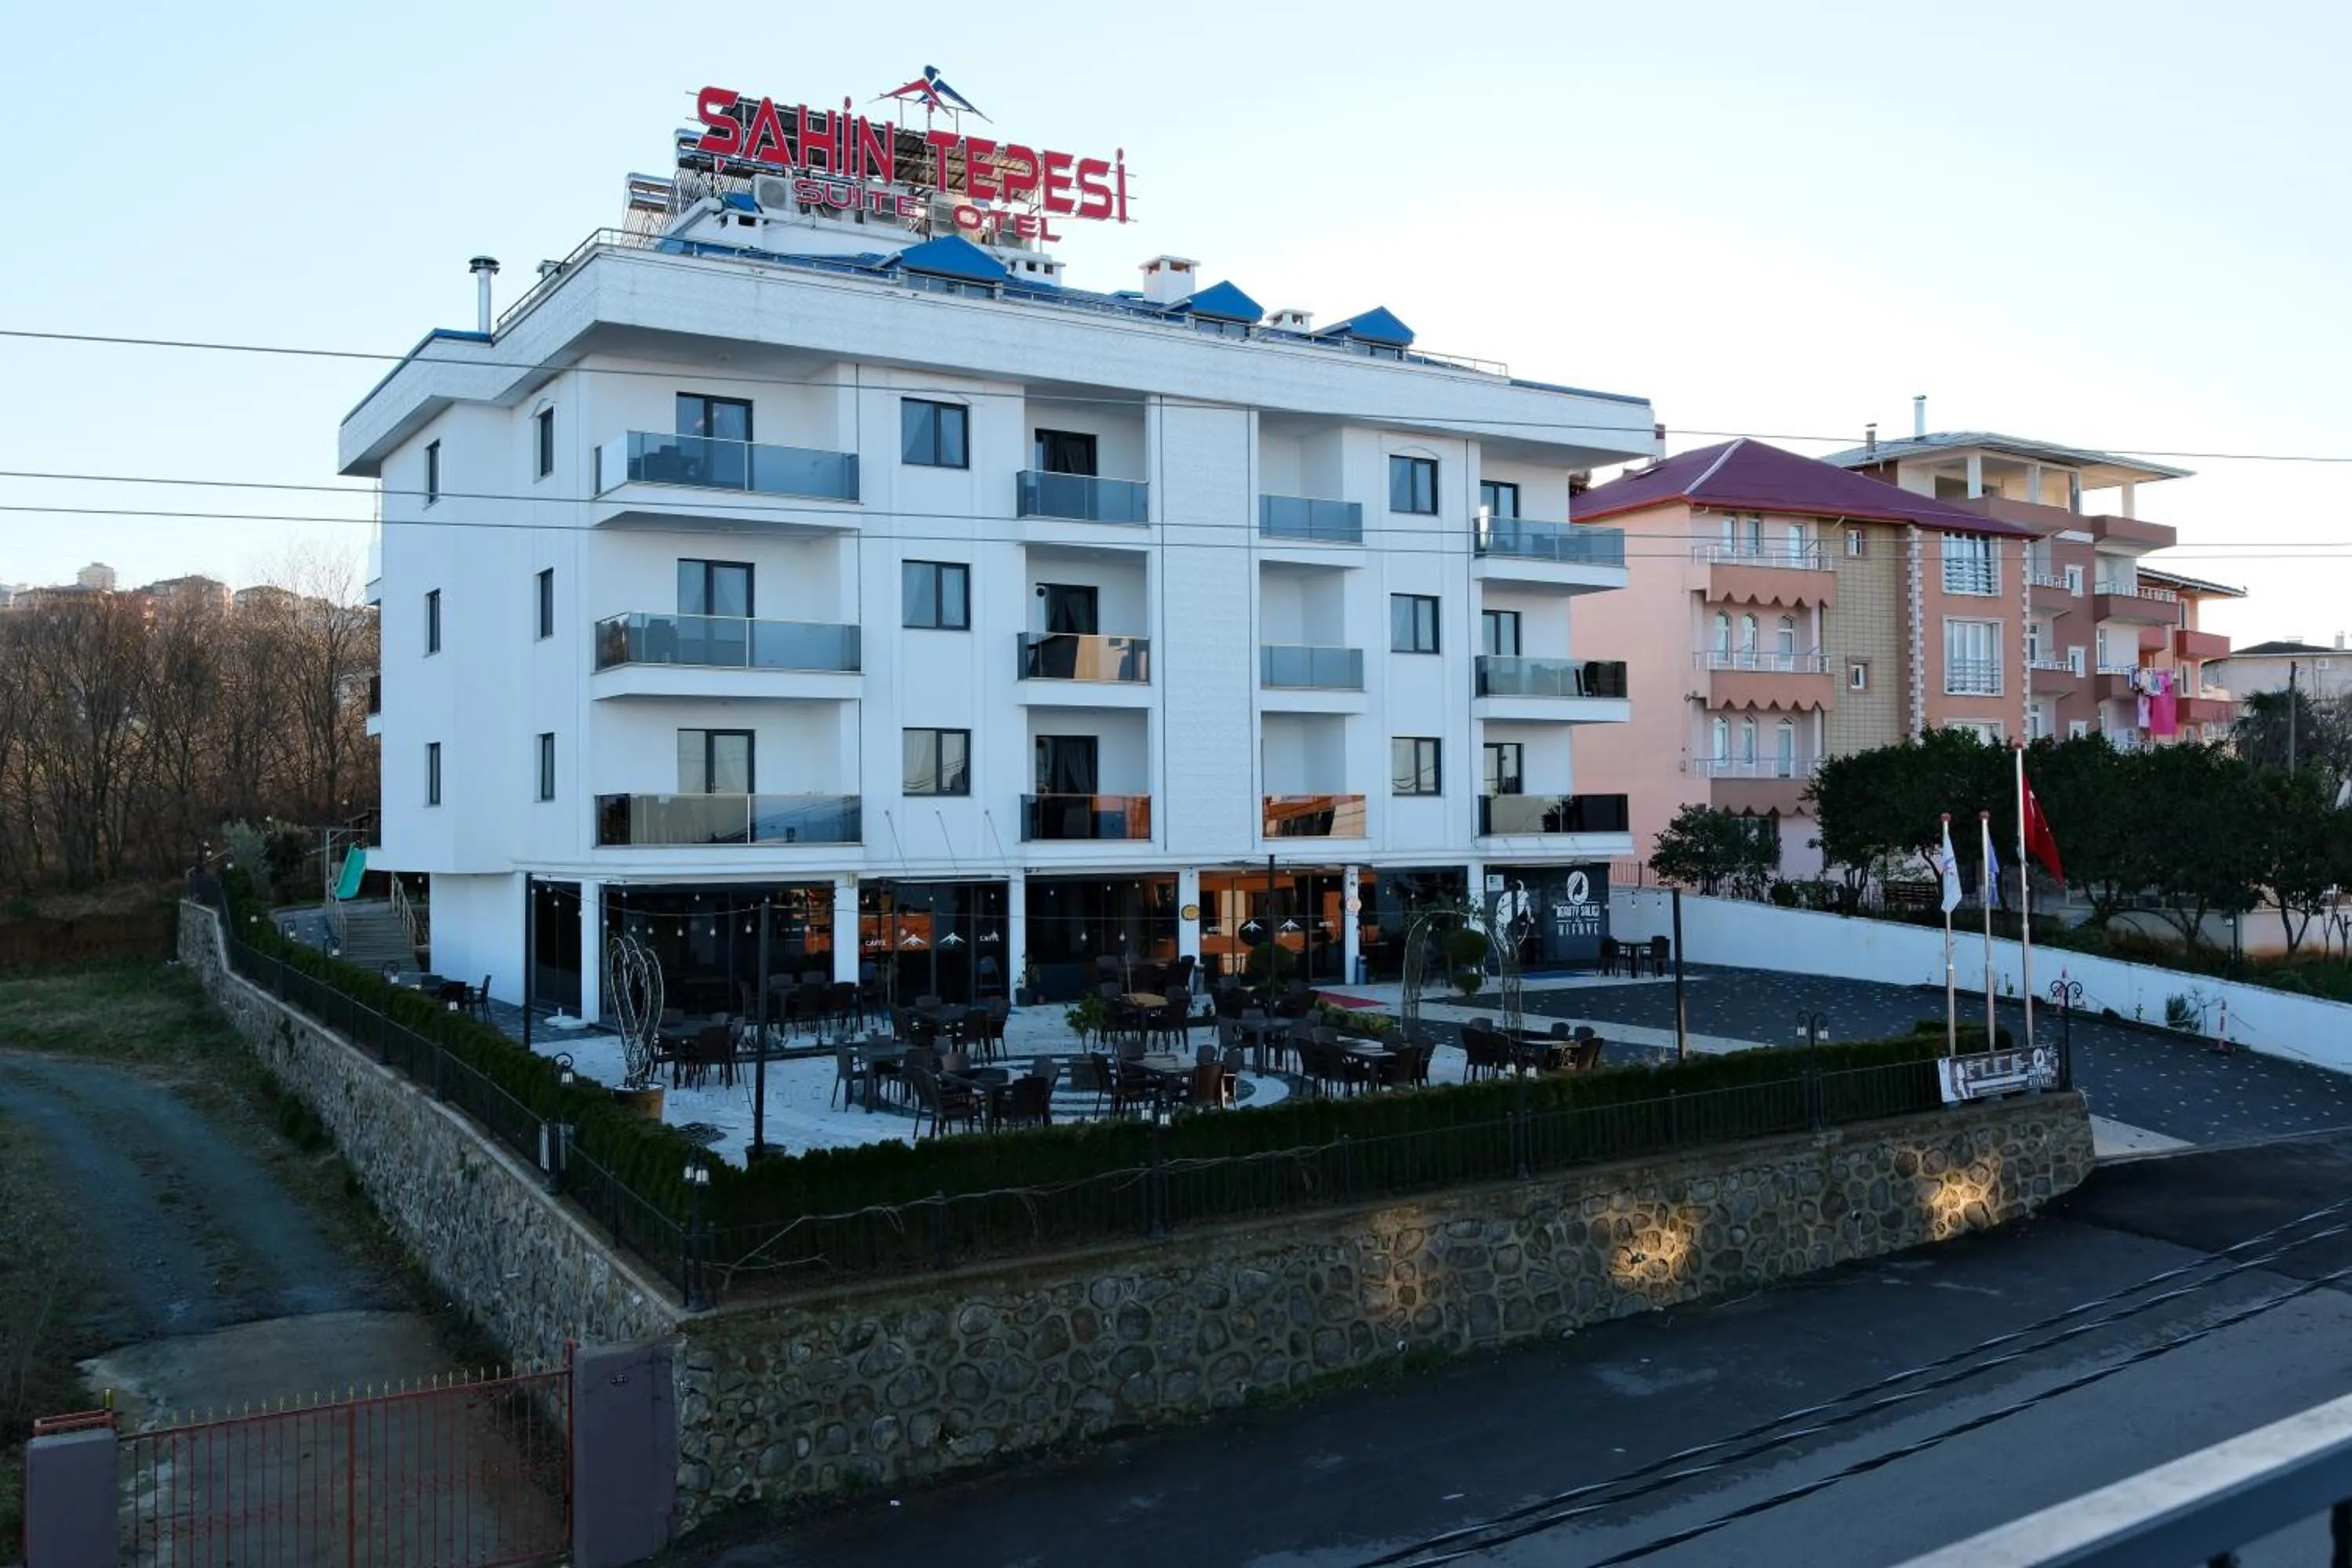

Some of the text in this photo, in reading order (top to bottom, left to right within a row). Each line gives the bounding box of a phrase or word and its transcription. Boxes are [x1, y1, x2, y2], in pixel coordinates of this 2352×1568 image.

[697, 86, 1127, 224] ŞAHİN TEPESİ
[953, 205, 1062, 242] OTEL
